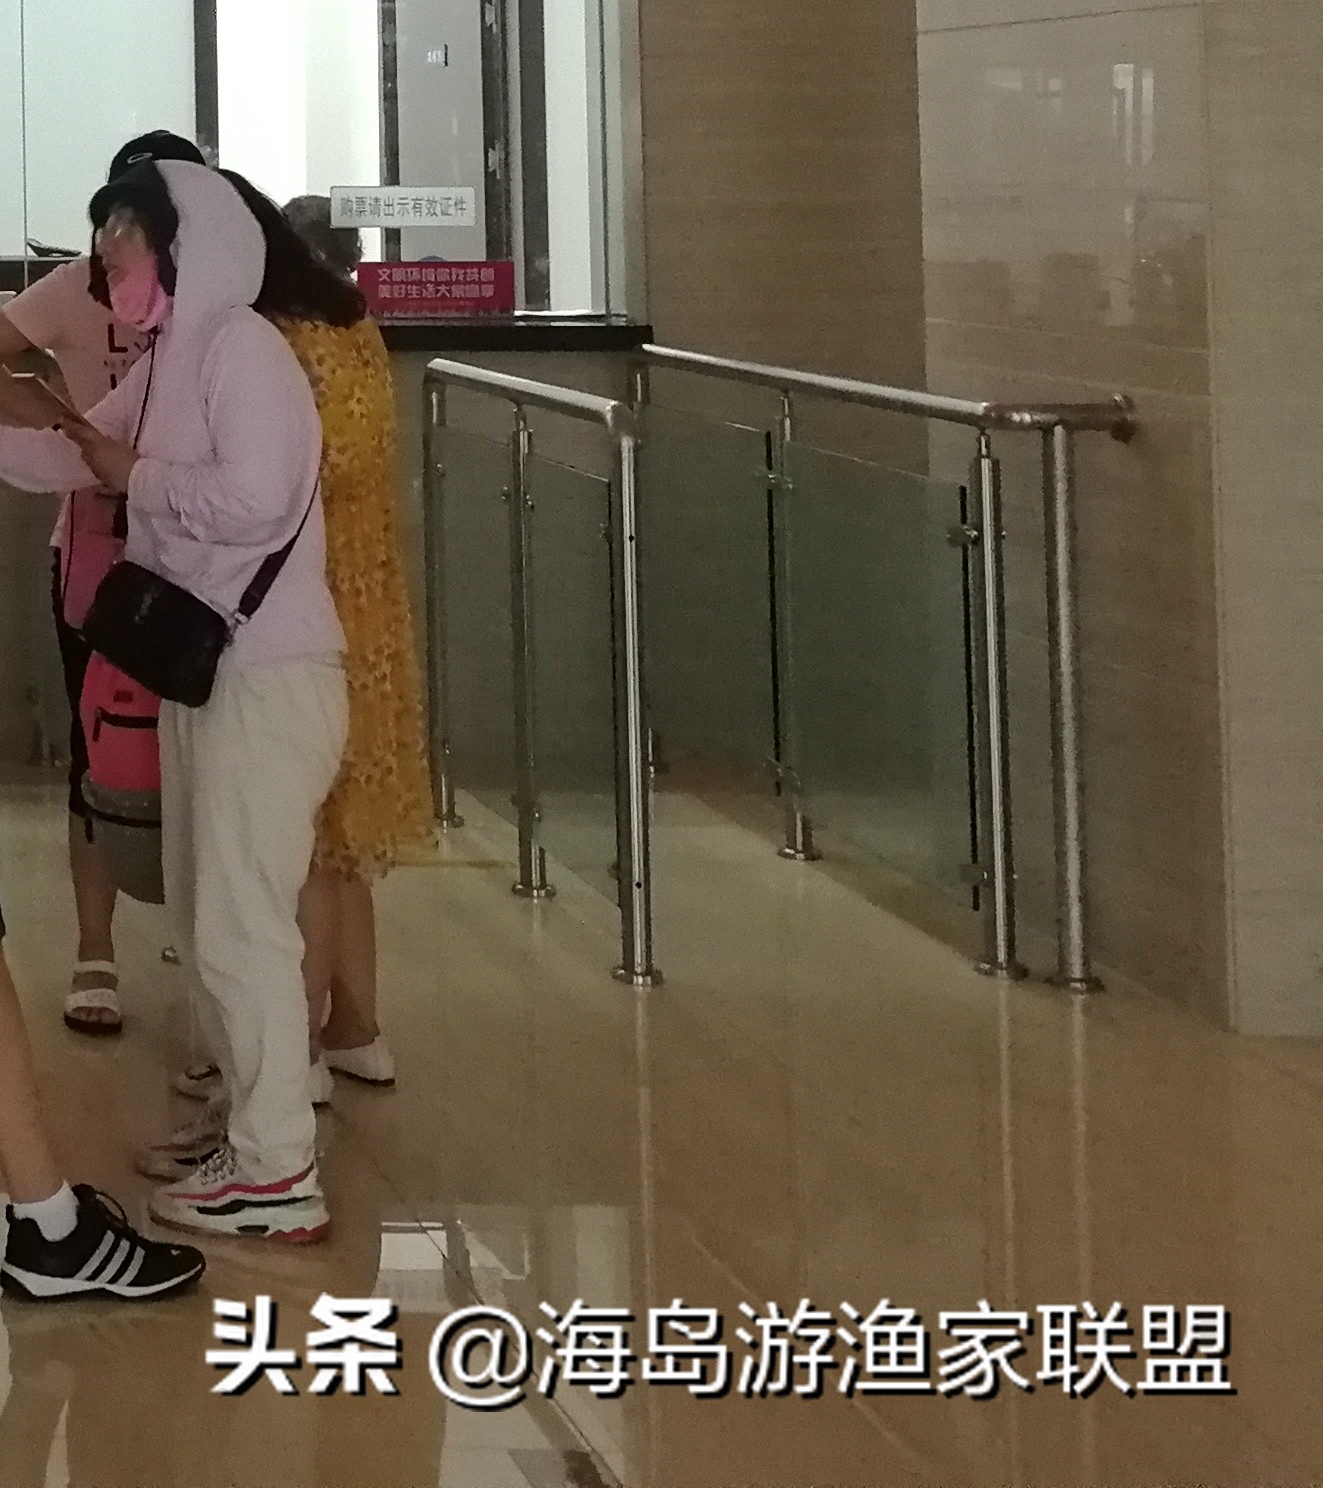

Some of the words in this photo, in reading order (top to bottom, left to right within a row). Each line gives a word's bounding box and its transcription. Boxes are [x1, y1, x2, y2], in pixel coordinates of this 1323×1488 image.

[339, 196, 468, 218] 购票请出示有效证件
